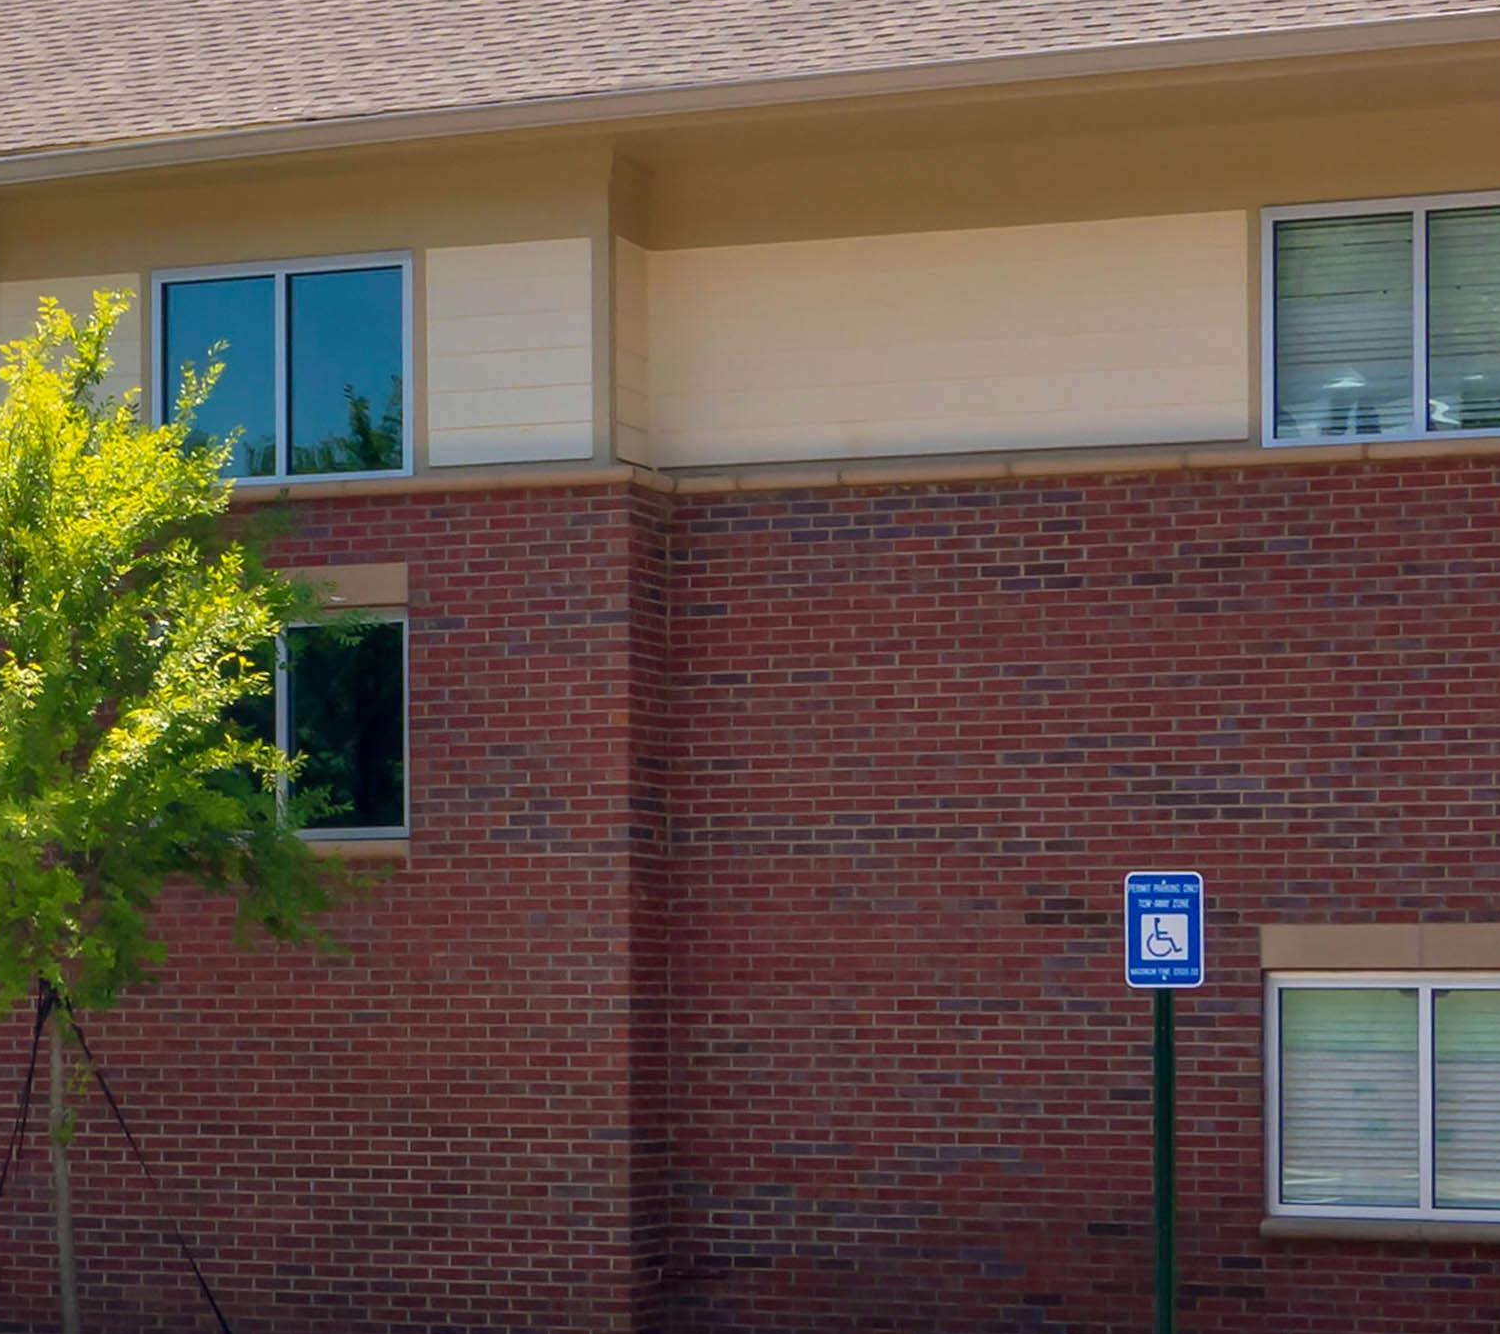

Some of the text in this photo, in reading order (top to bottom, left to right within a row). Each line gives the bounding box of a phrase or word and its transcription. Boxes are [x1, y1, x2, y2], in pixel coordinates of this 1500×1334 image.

[1128, 883, 1199, 893] PERMIT PARKING ONLY
[1172, 899, 1189, 908] ZONE
